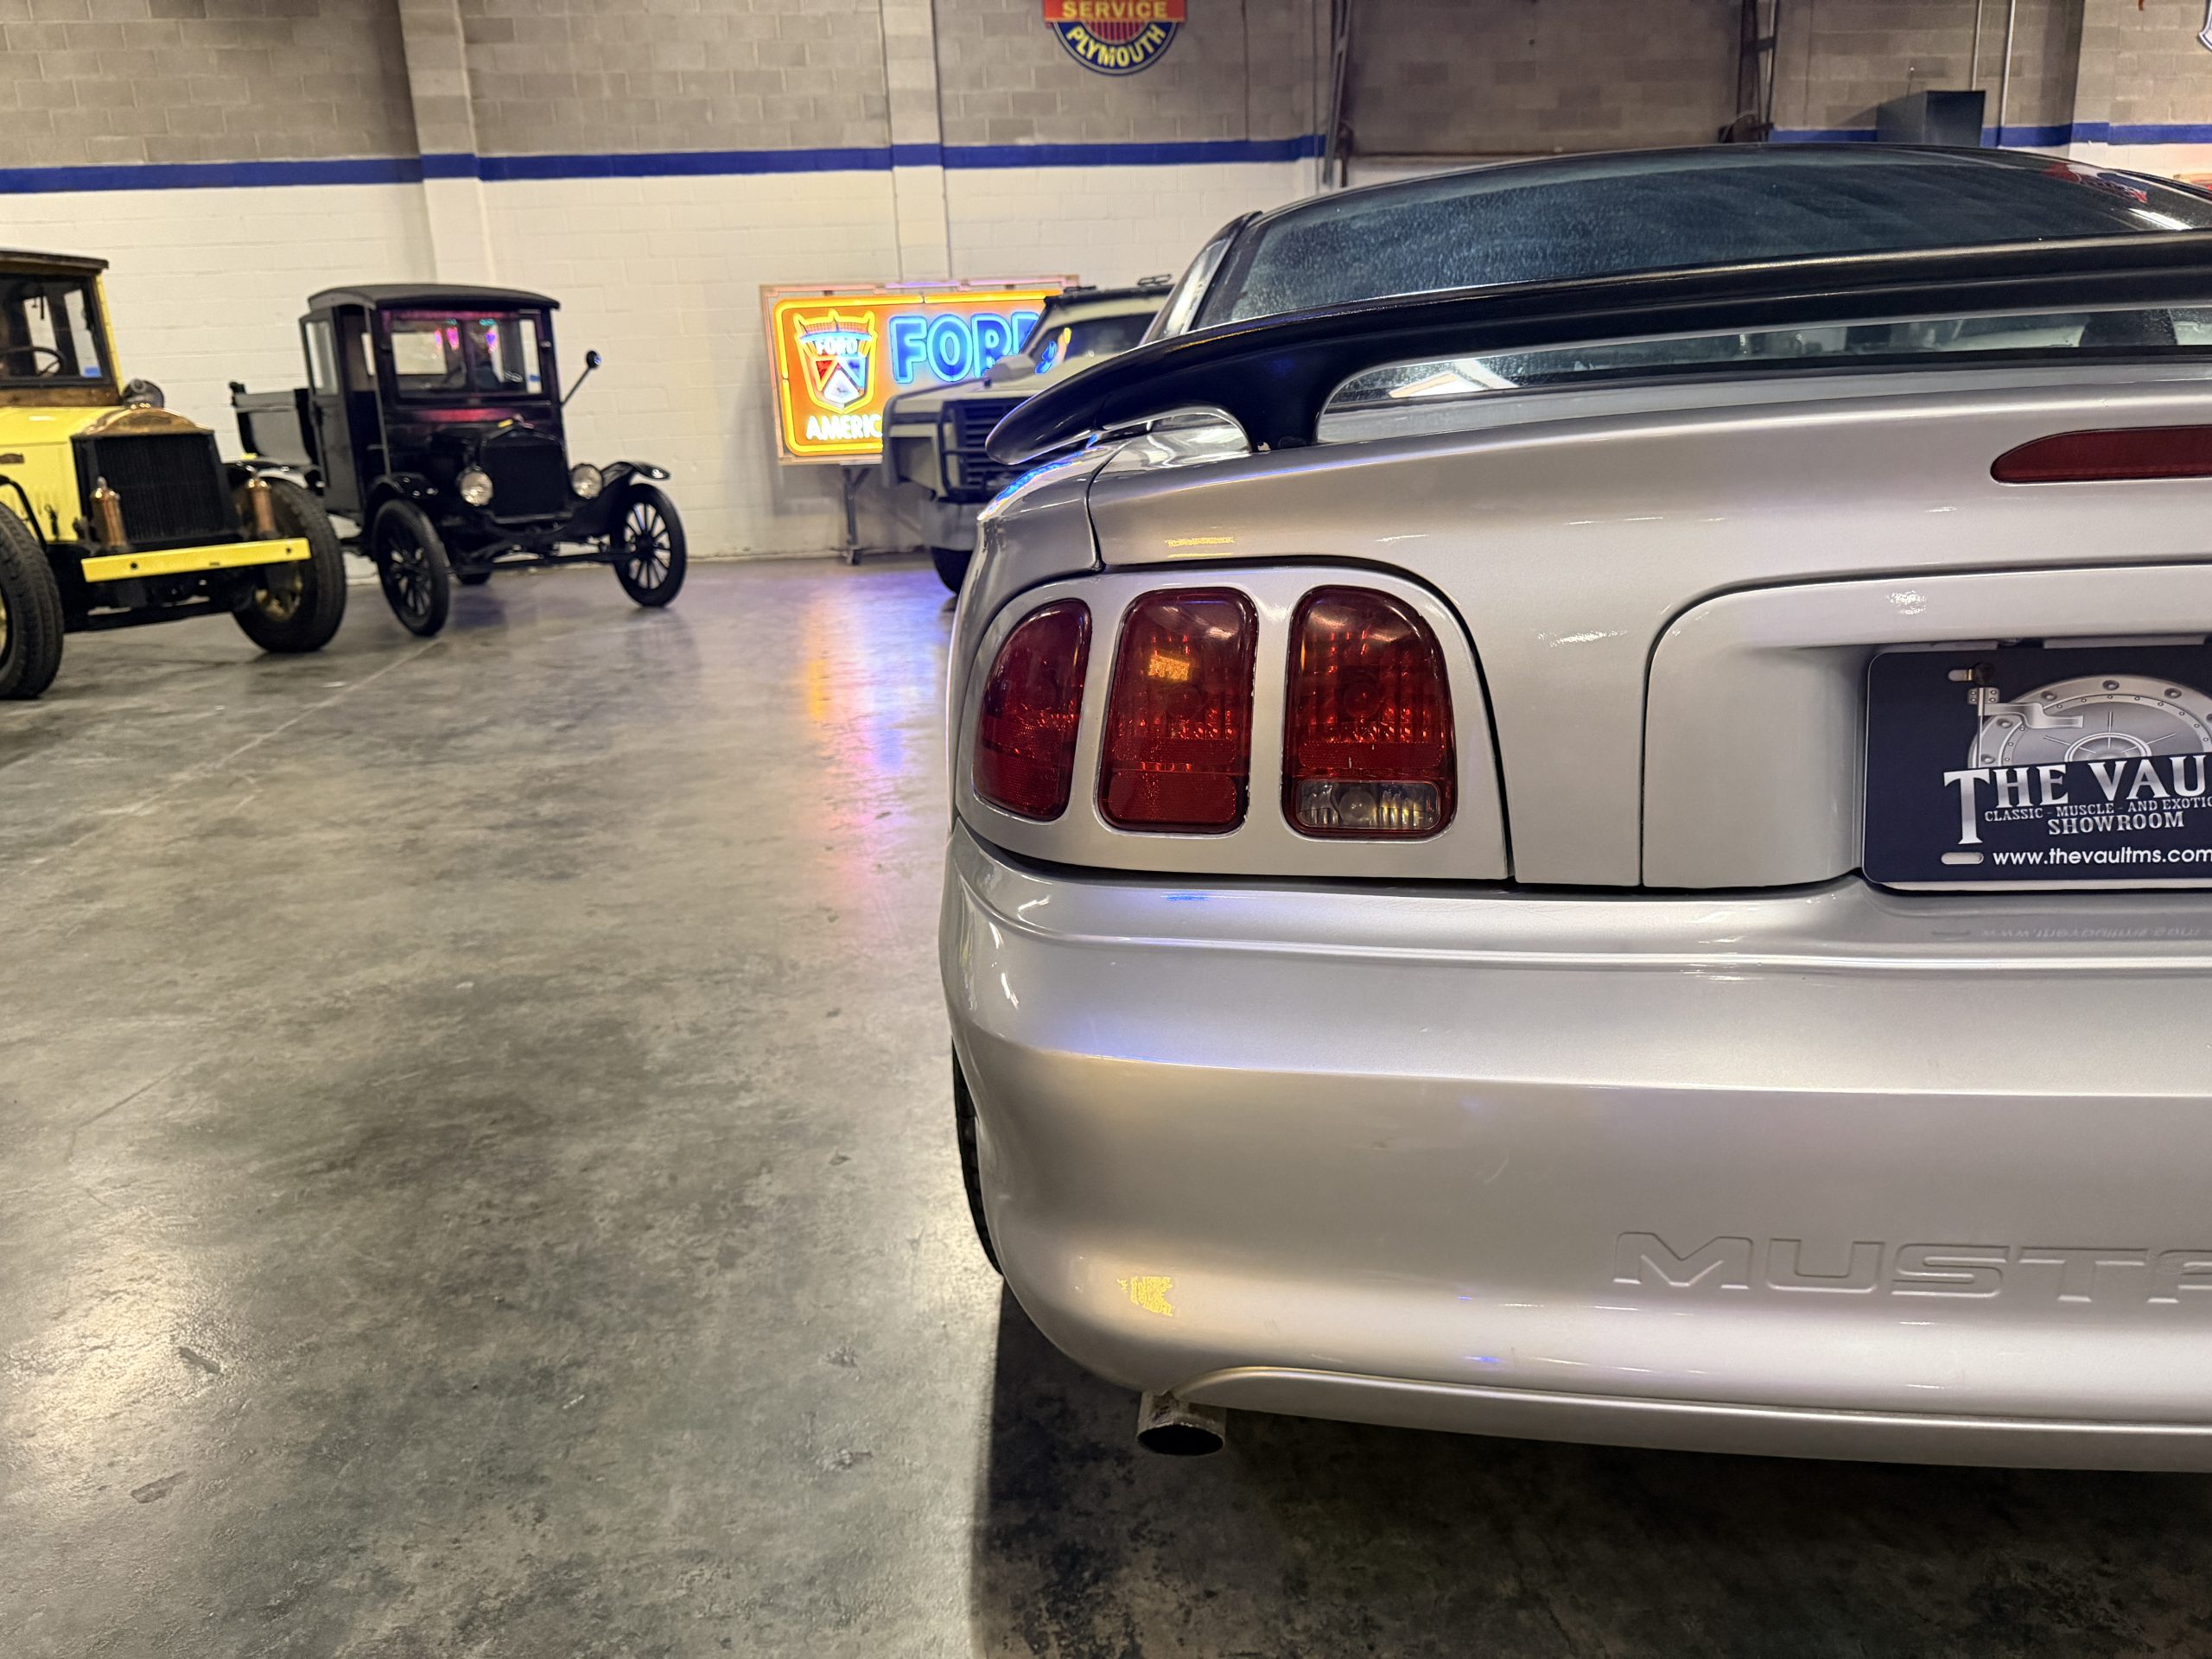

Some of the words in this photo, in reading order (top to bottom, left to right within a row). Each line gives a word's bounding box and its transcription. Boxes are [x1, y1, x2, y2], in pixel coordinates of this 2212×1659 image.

[1062, 0, 1167, 18] SERVICE
[1066, 24, 1166, 67] PLYMOUTH
[1943, 765, 2069, 845] THE
[2088, 754, 2207, 802] VAU
[1984, 807, 2044, 822] CLASSIC
[2056, 803, 2114, 817] MUSCLE
[2127, 799, 2158, 812] AND
[2047, 810, 2185, 836] SHOWROOM
[1993, 846, 2212, 866] www.thevaultms.com
